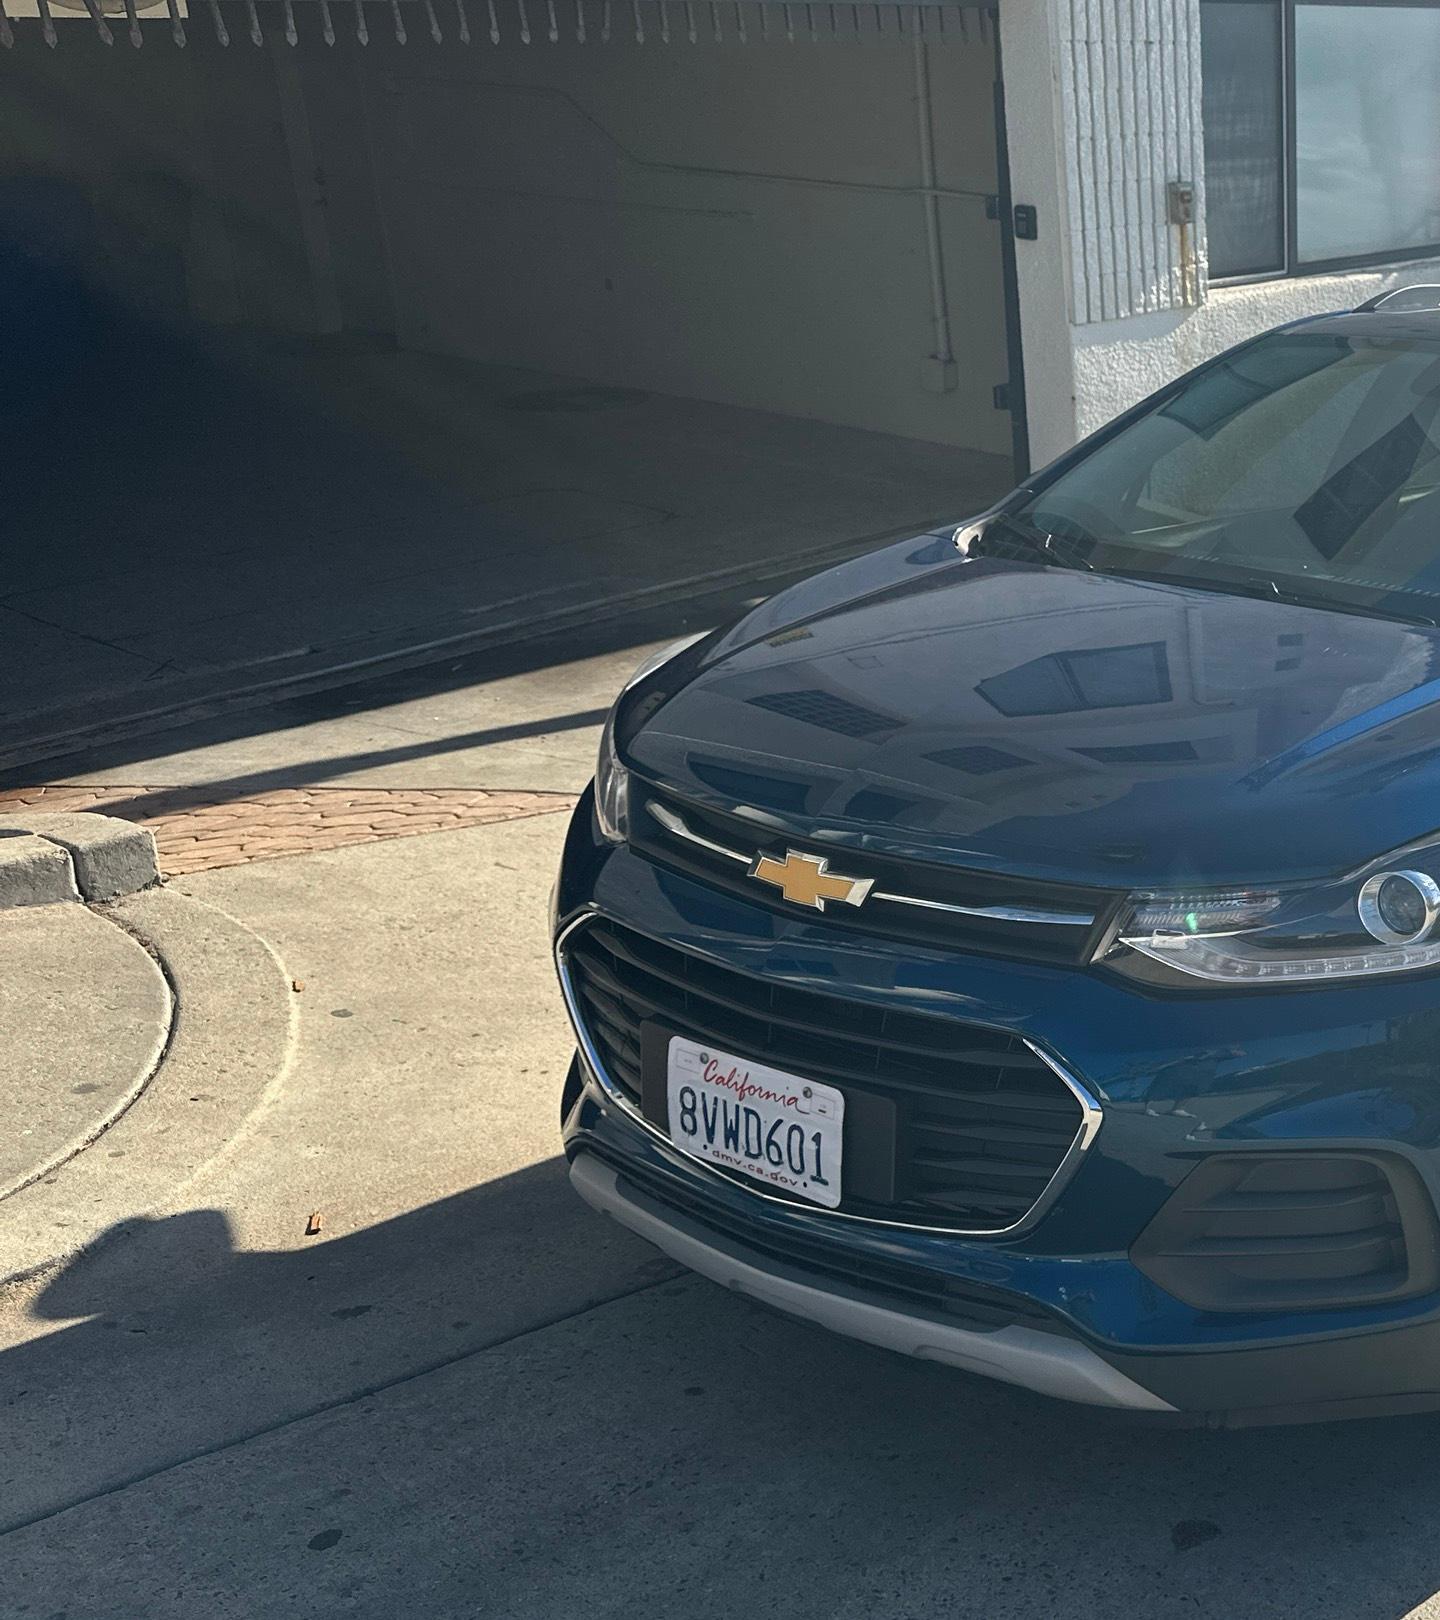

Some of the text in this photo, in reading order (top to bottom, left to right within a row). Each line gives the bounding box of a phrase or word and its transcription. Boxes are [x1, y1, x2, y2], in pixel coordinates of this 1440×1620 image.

[703, 1059, 810, 1114] California
[680, 1086, 829, 1186] 8VWD601
[712, 1150, 798, 1186] dmv.ca.gov
